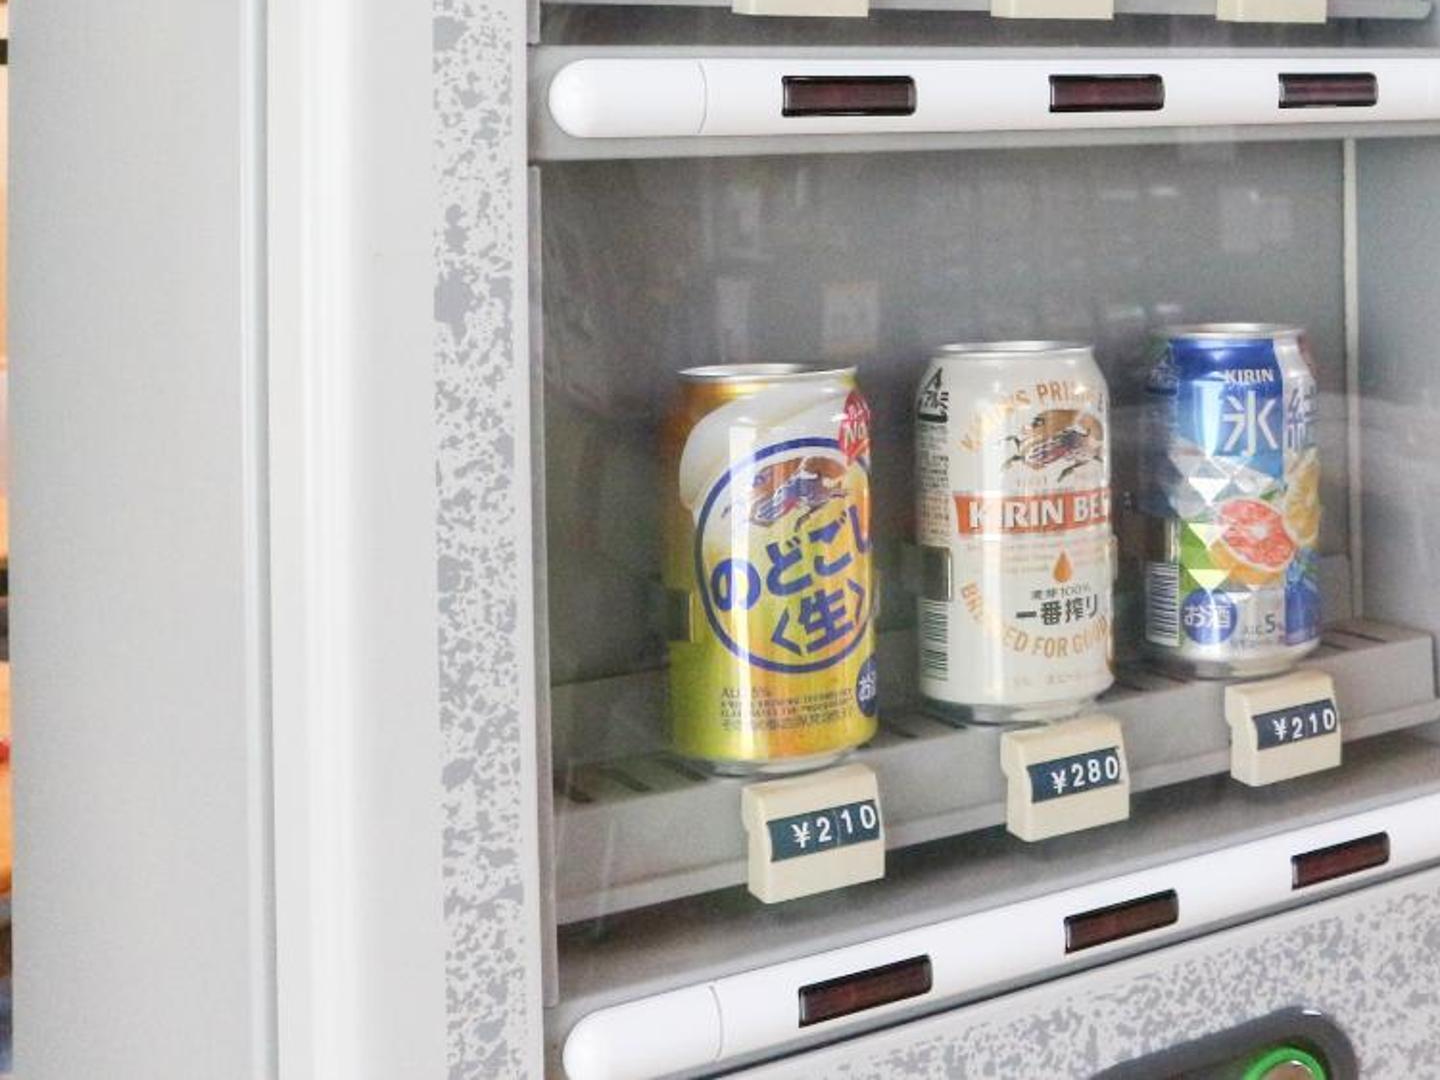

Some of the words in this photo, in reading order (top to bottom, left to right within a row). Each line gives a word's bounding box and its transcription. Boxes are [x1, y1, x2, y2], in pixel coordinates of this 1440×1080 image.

[1224, 368, 1274, 385] KIRIN
[968, 497, 1064, 528] KRIN
[710, 504, 872, 612] のどごし
[1015, 594, 1099, 626] 一番搾り
[1274, 708, 1336, 742] ¥210
[1052, 754, 1120, 795] ¥280
[793, 804, 878, 848] ¥210
